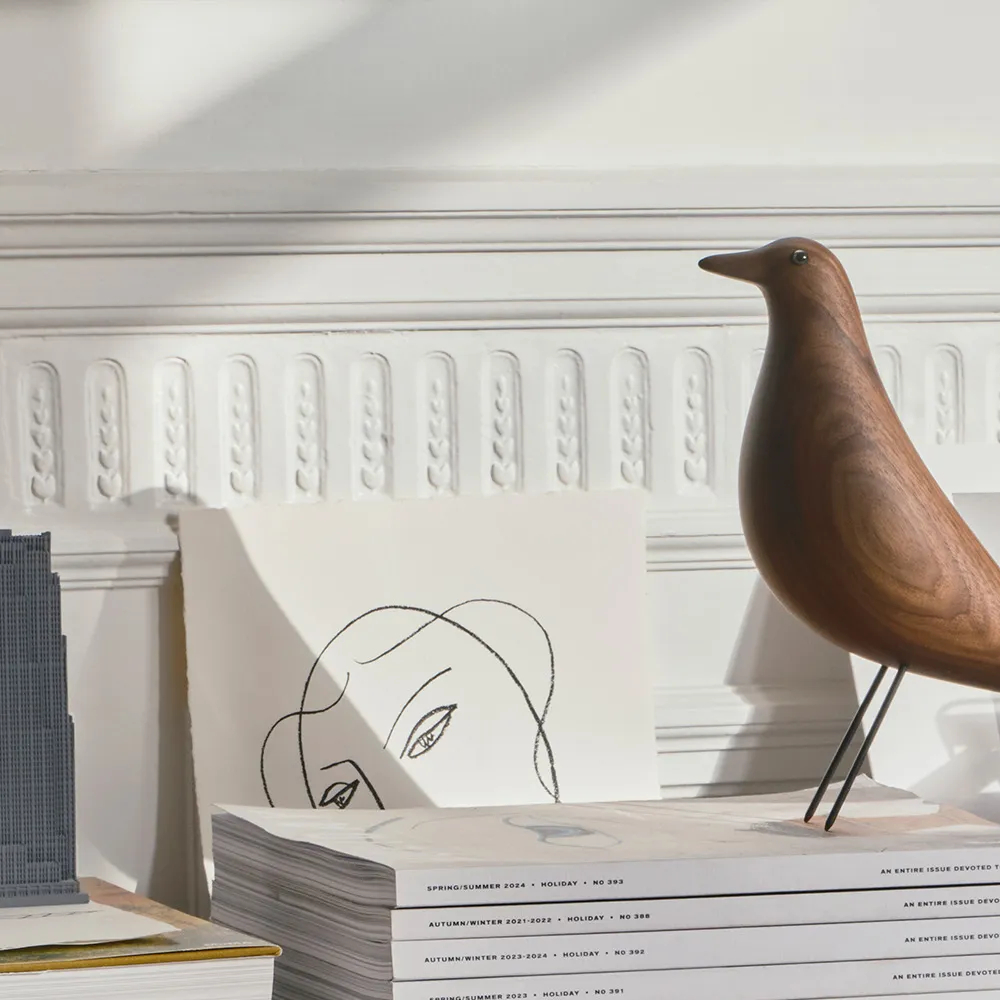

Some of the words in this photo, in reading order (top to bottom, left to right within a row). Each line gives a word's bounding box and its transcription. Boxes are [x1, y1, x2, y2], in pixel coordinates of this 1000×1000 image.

[953, 864, 992, 872] DEVOTED
[426, 883, 501, 892] SPRING/SUMMER
[540, 880, 578, 888] HOLIDAY
[607, 878, 624, 886] 393
